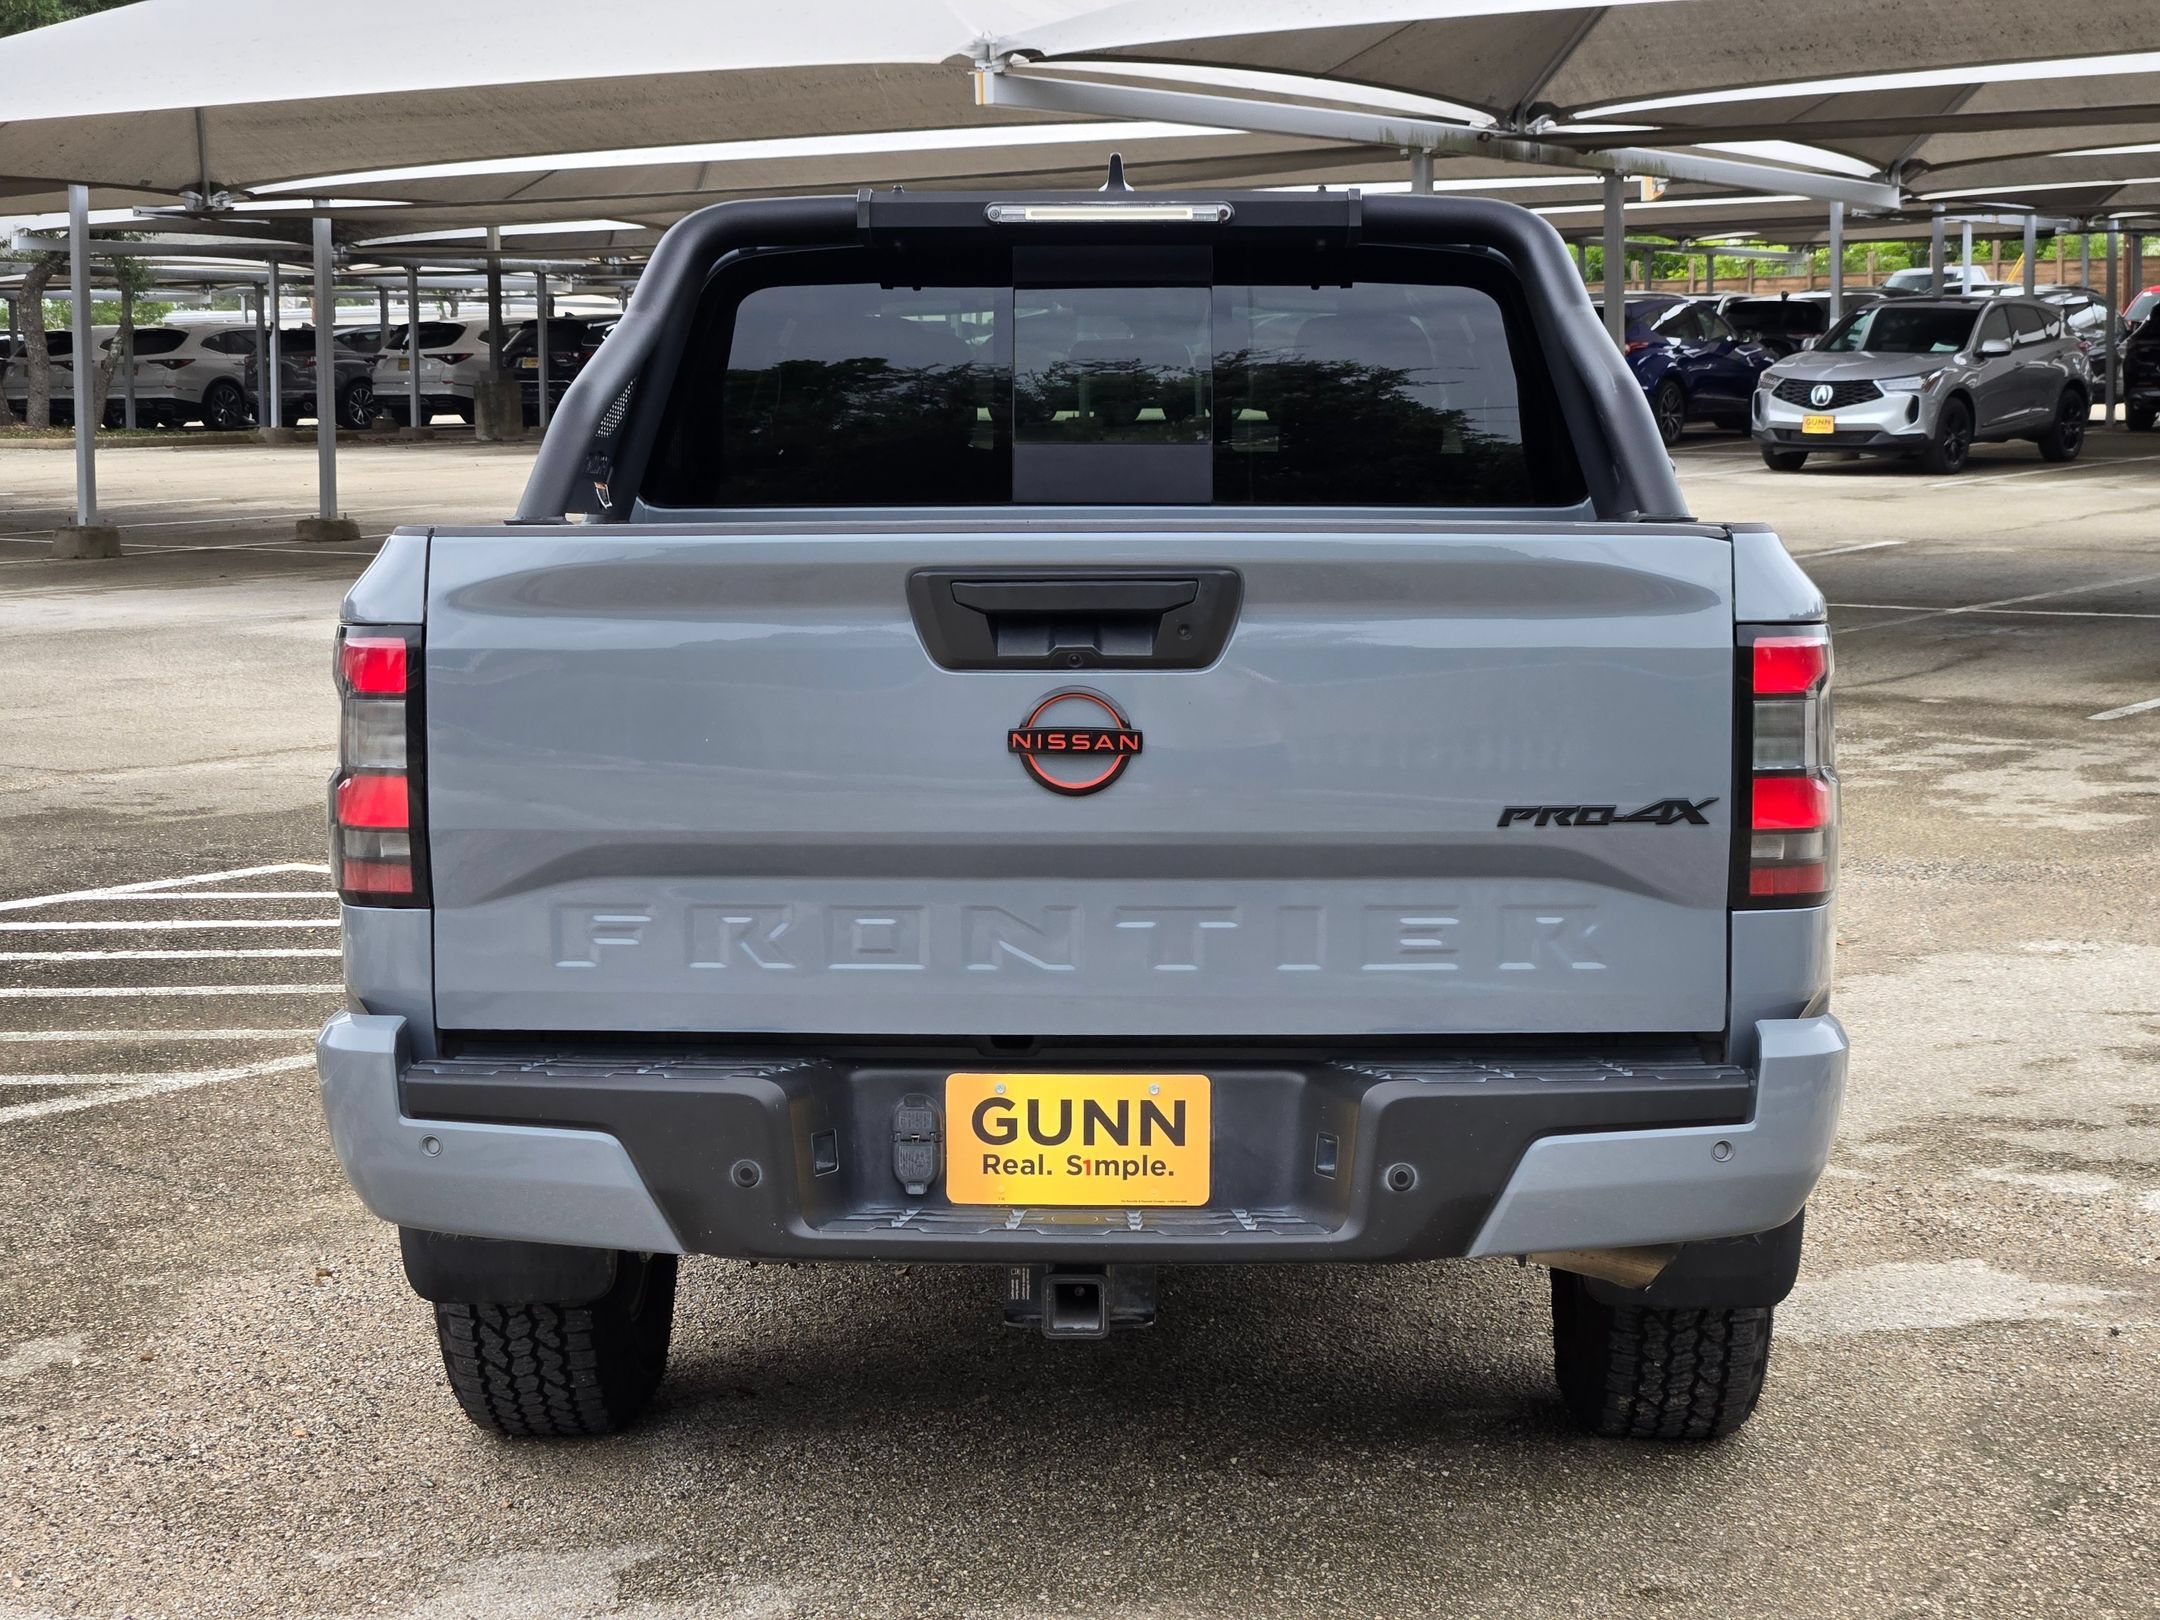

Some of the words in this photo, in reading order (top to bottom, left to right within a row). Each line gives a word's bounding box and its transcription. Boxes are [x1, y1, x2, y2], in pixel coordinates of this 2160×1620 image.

[1012, 733, 1139, 751] NISSAN
[1497, 797, 1720, 827] PRO-4X
[552, 903, 1607, 970] FRONTIER
[971, 1096, 1186, 1147] GUNN
[982, 1153, 1053, 1176] Real.
